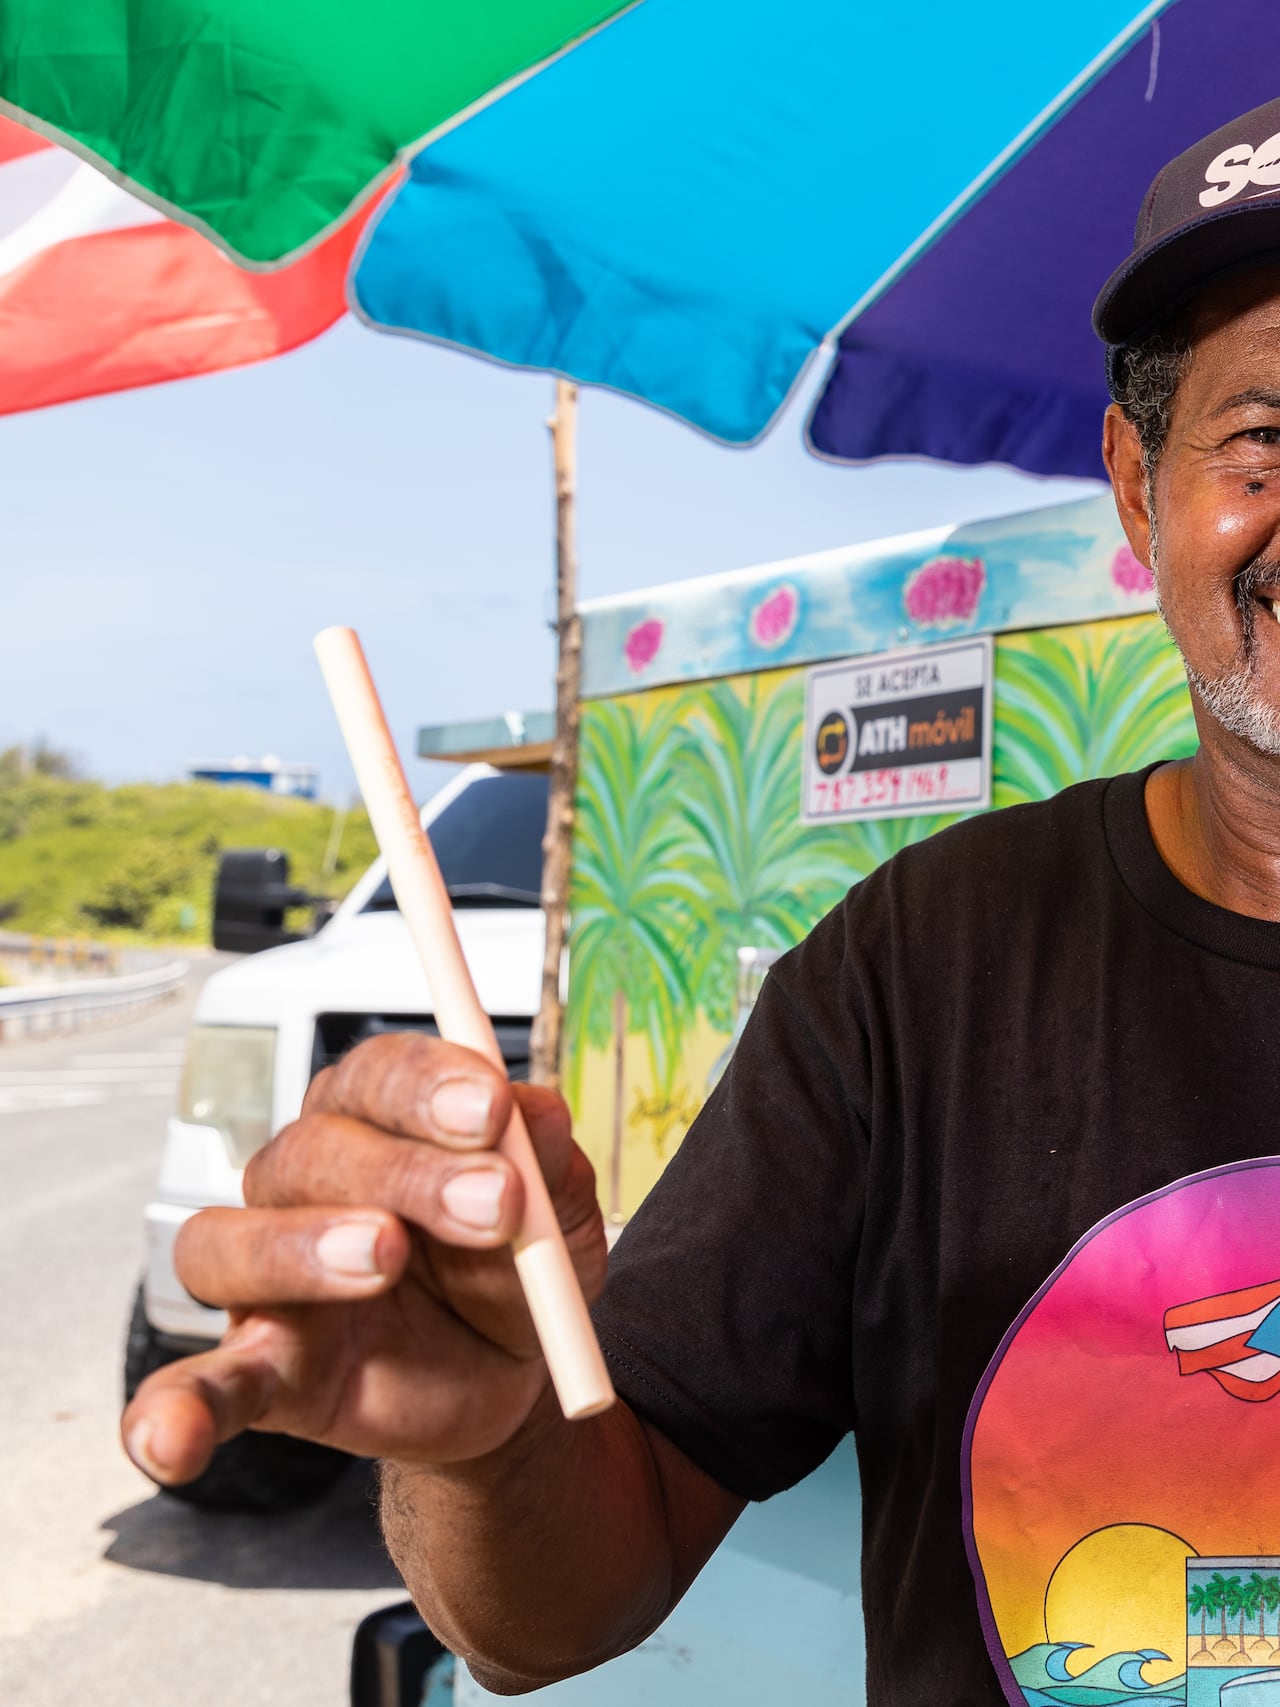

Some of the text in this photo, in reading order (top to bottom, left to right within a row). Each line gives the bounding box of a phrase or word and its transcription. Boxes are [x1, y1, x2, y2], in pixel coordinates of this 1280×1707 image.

[855, 663, 940, 697] SE ACEPTA
[858, 706, 975, 756] ATH móvil
